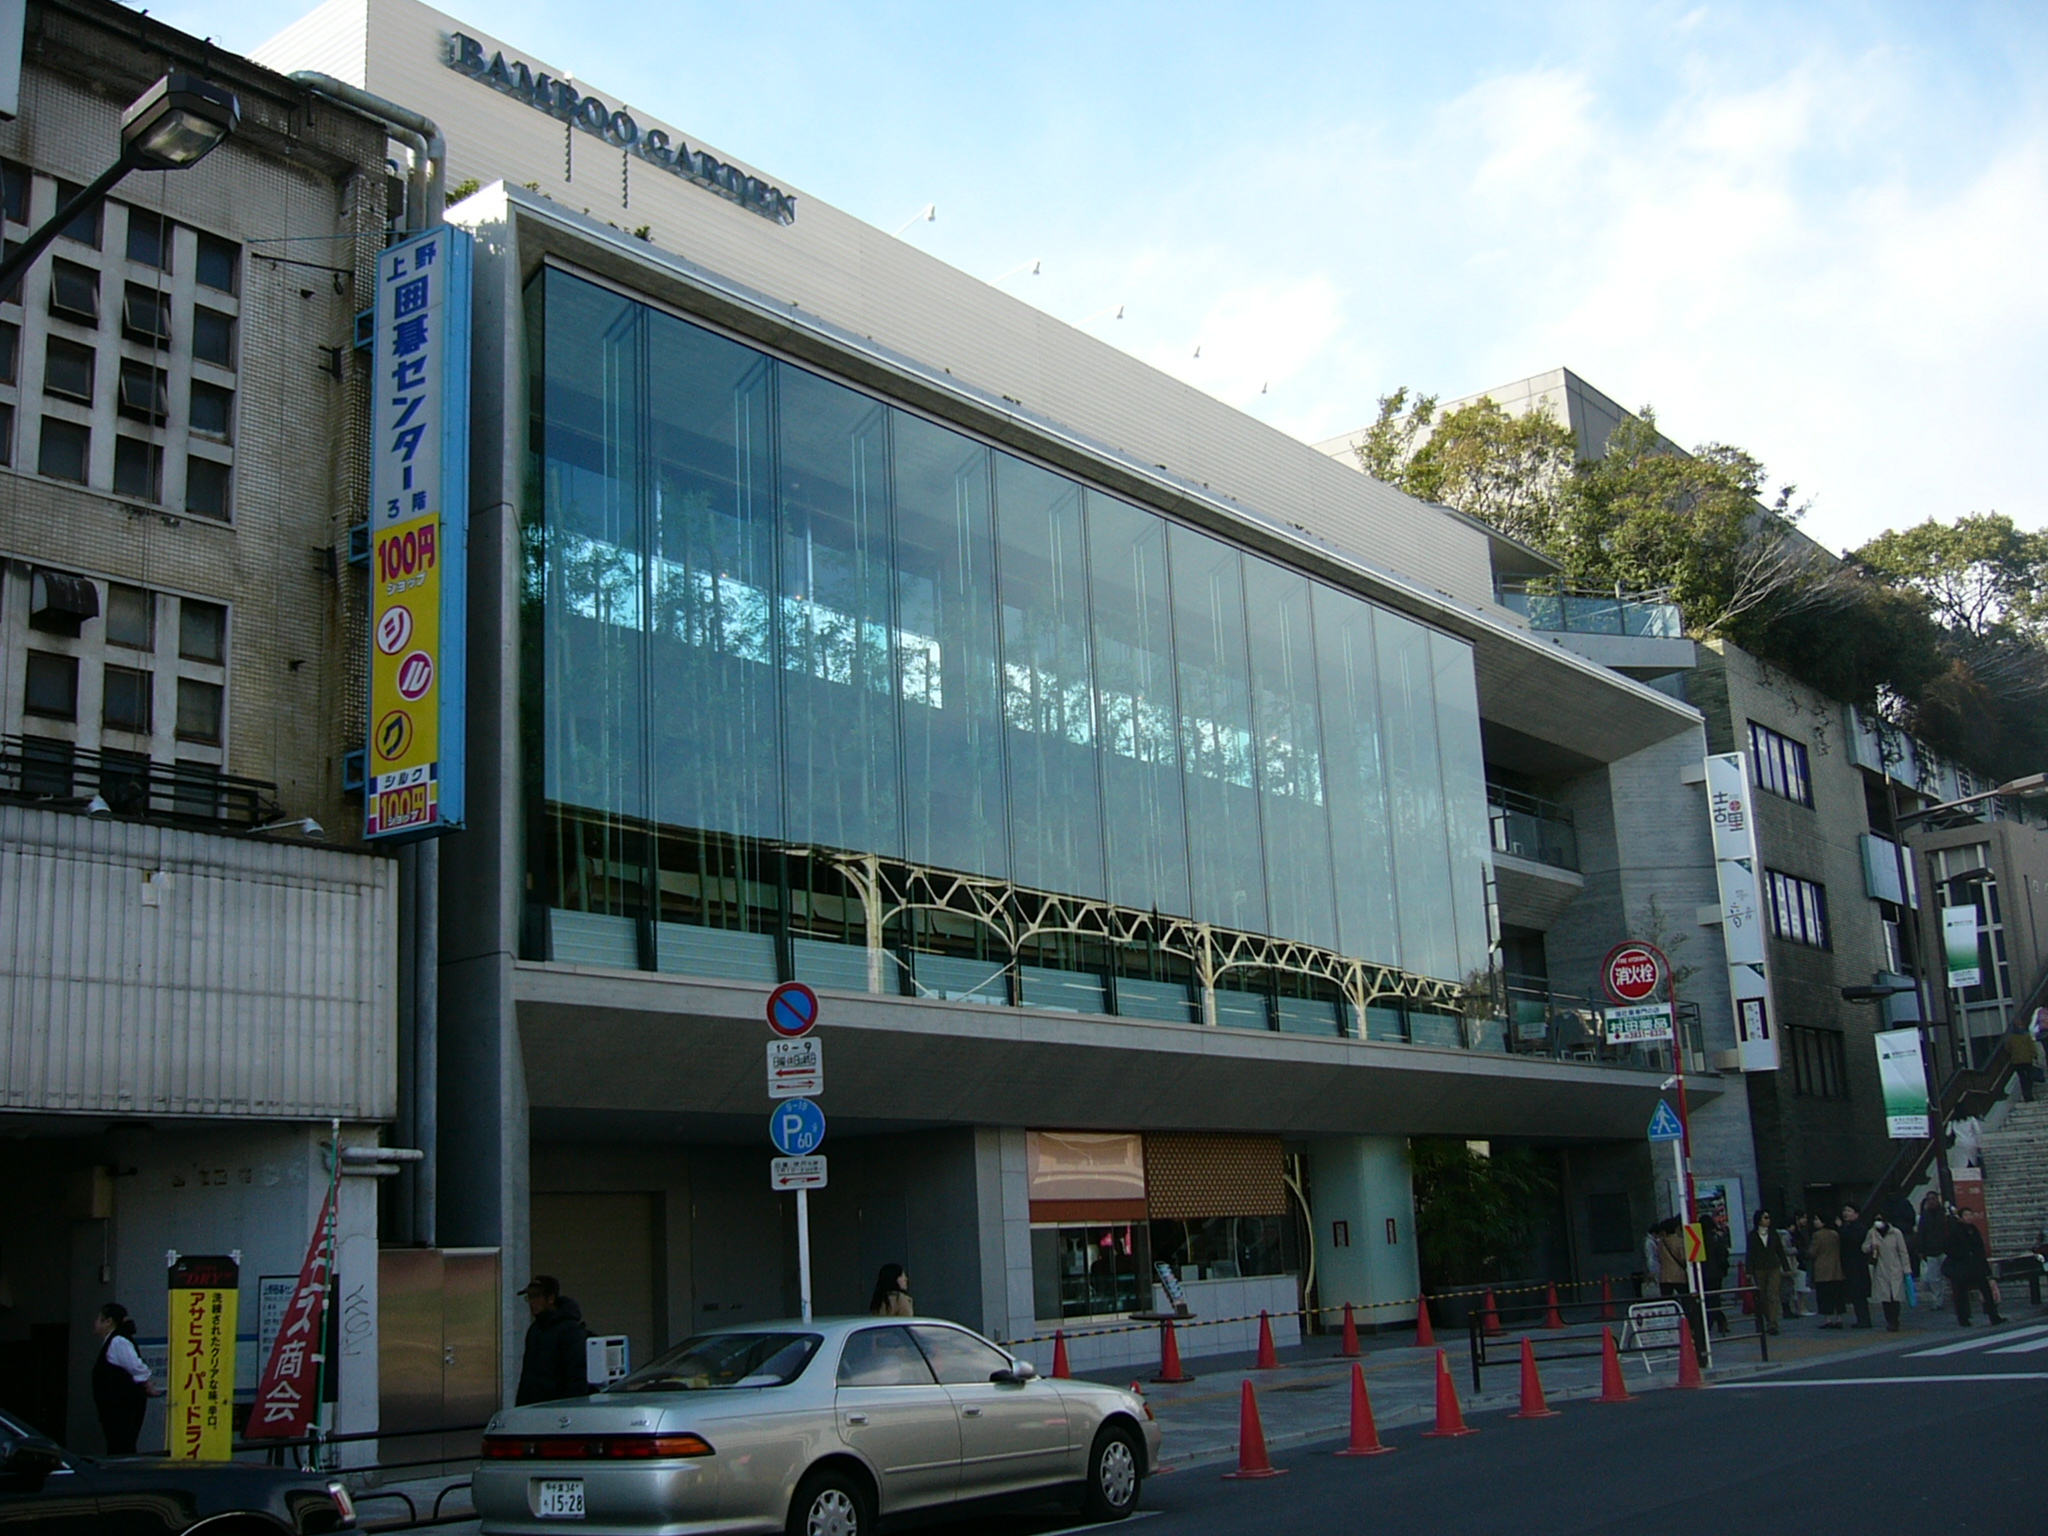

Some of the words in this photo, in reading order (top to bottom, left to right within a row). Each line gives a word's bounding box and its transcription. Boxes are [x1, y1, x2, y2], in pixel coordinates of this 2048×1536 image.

[450, 31, 638, 146] BAMBOO
[646, 128, 798, 227] GARDEN
[386, 240, 437, 282] 上野
[391, 274, 429, 491] 囲碁センター
[378, 524, 436, 583] 100円
[386, 571, 427, 596] ショップ
[383, 768, 423, 788] シルク
[1614, 963, 1655, 986] 消火栓
[782, 1113, 803, 1150] P
[551, 1494, 583, 1512] 15-28
